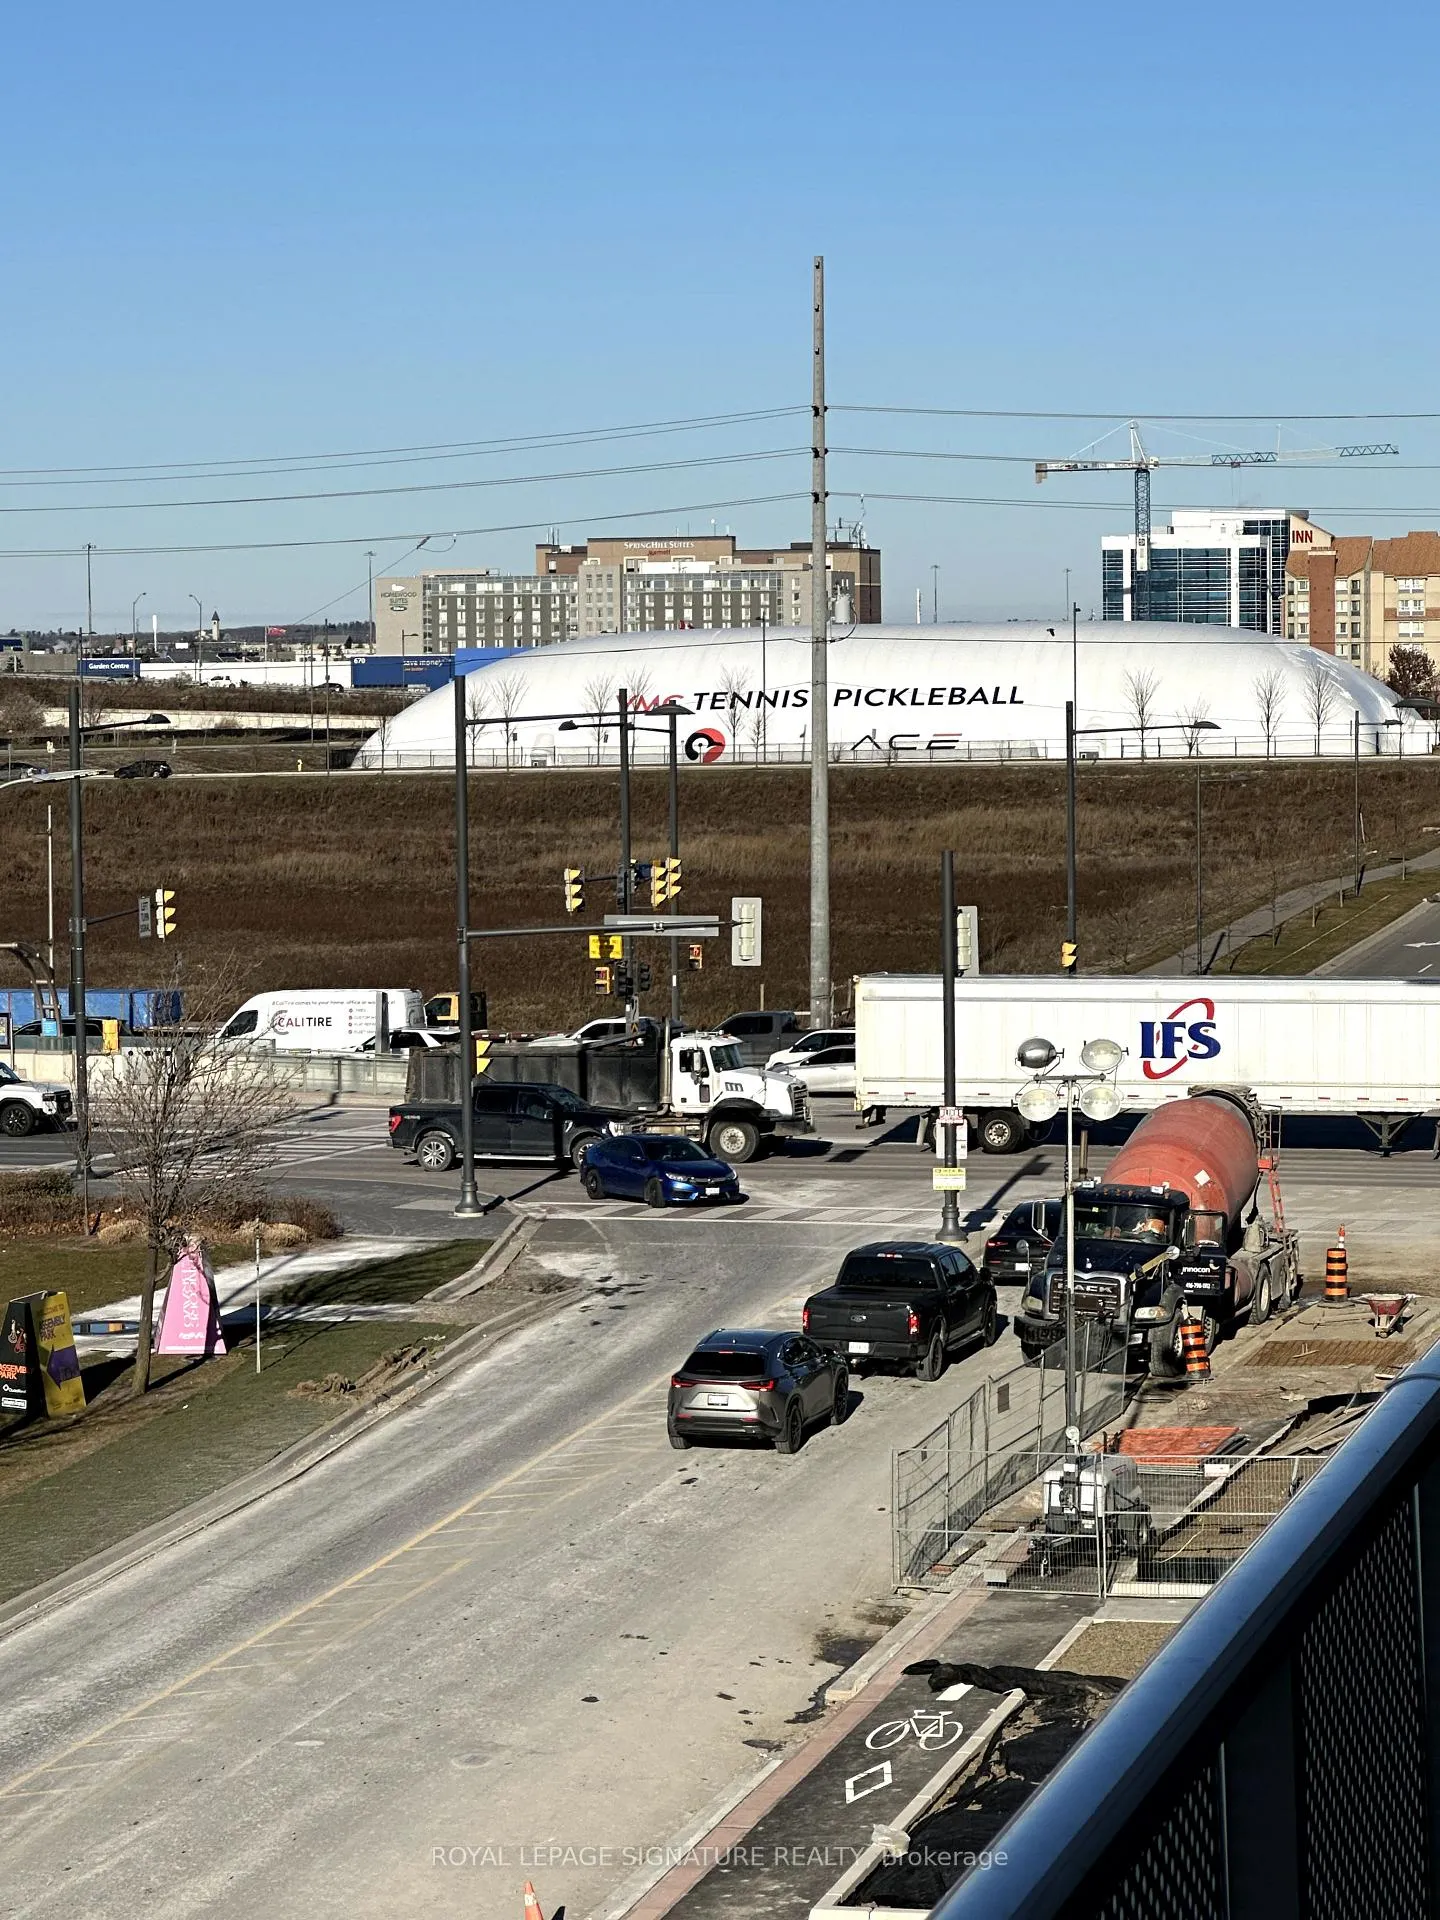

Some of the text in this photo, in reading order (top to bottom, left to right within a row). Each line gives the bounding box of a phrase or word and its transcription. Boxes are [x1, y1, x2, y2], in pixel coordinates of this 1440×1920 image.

[1292, 530, 1313, 543] INN
[693, 689, 810, 711] TENNIS
[833, 686, 1024, 707] PICKLEBALL
[1139, 1021, 1221, 1059] IFS
